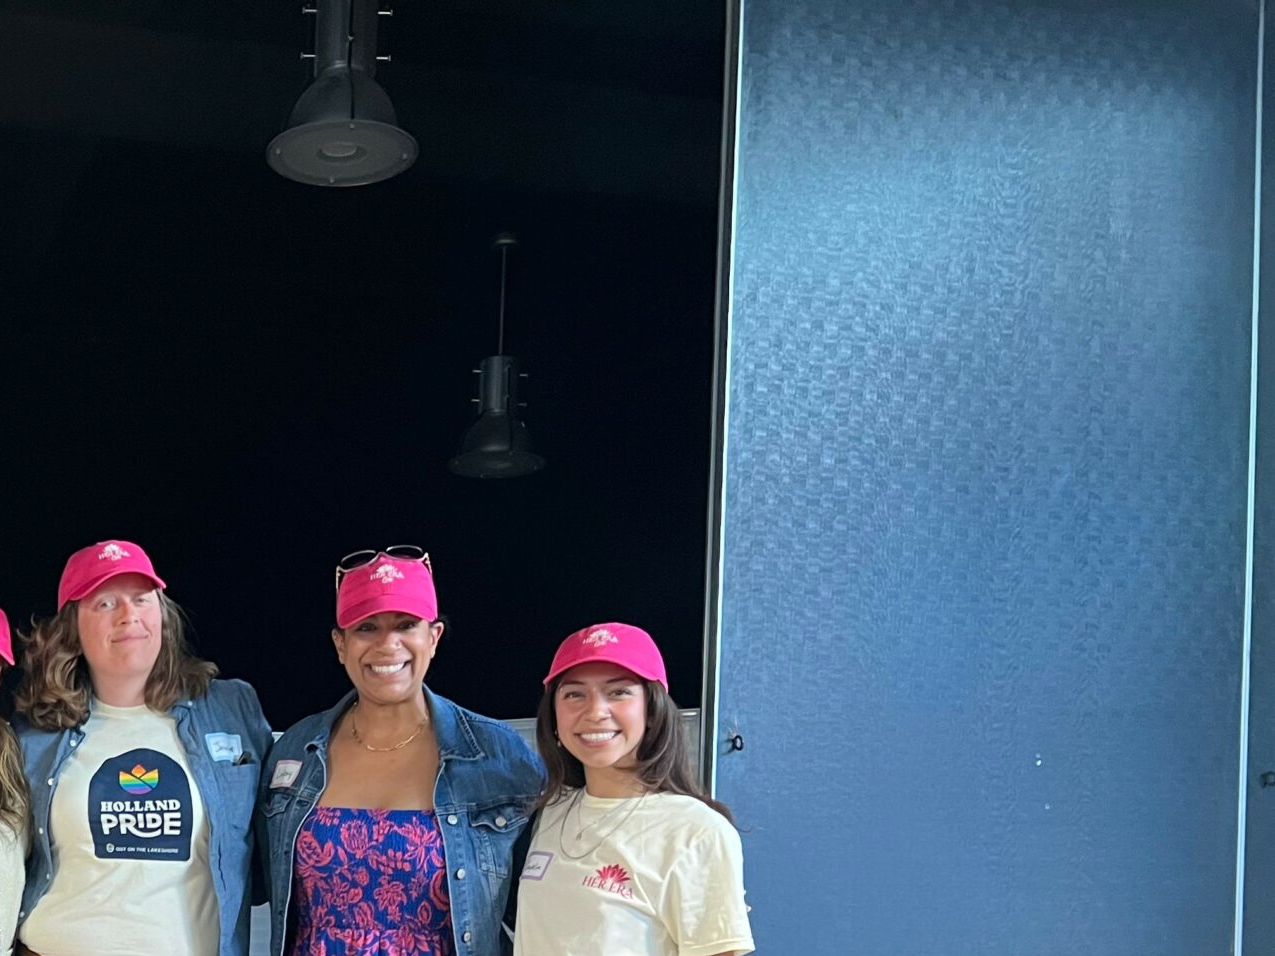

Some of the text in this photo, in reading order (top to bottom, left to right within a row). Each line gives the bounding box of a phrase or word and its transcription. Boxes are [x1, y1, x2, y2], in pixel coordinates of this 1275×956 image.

[100, 799, 181, 812] HOLLAND
[100, 812, 182, 838] PRIDE
[582, 876, 634, 900] HER ERA
